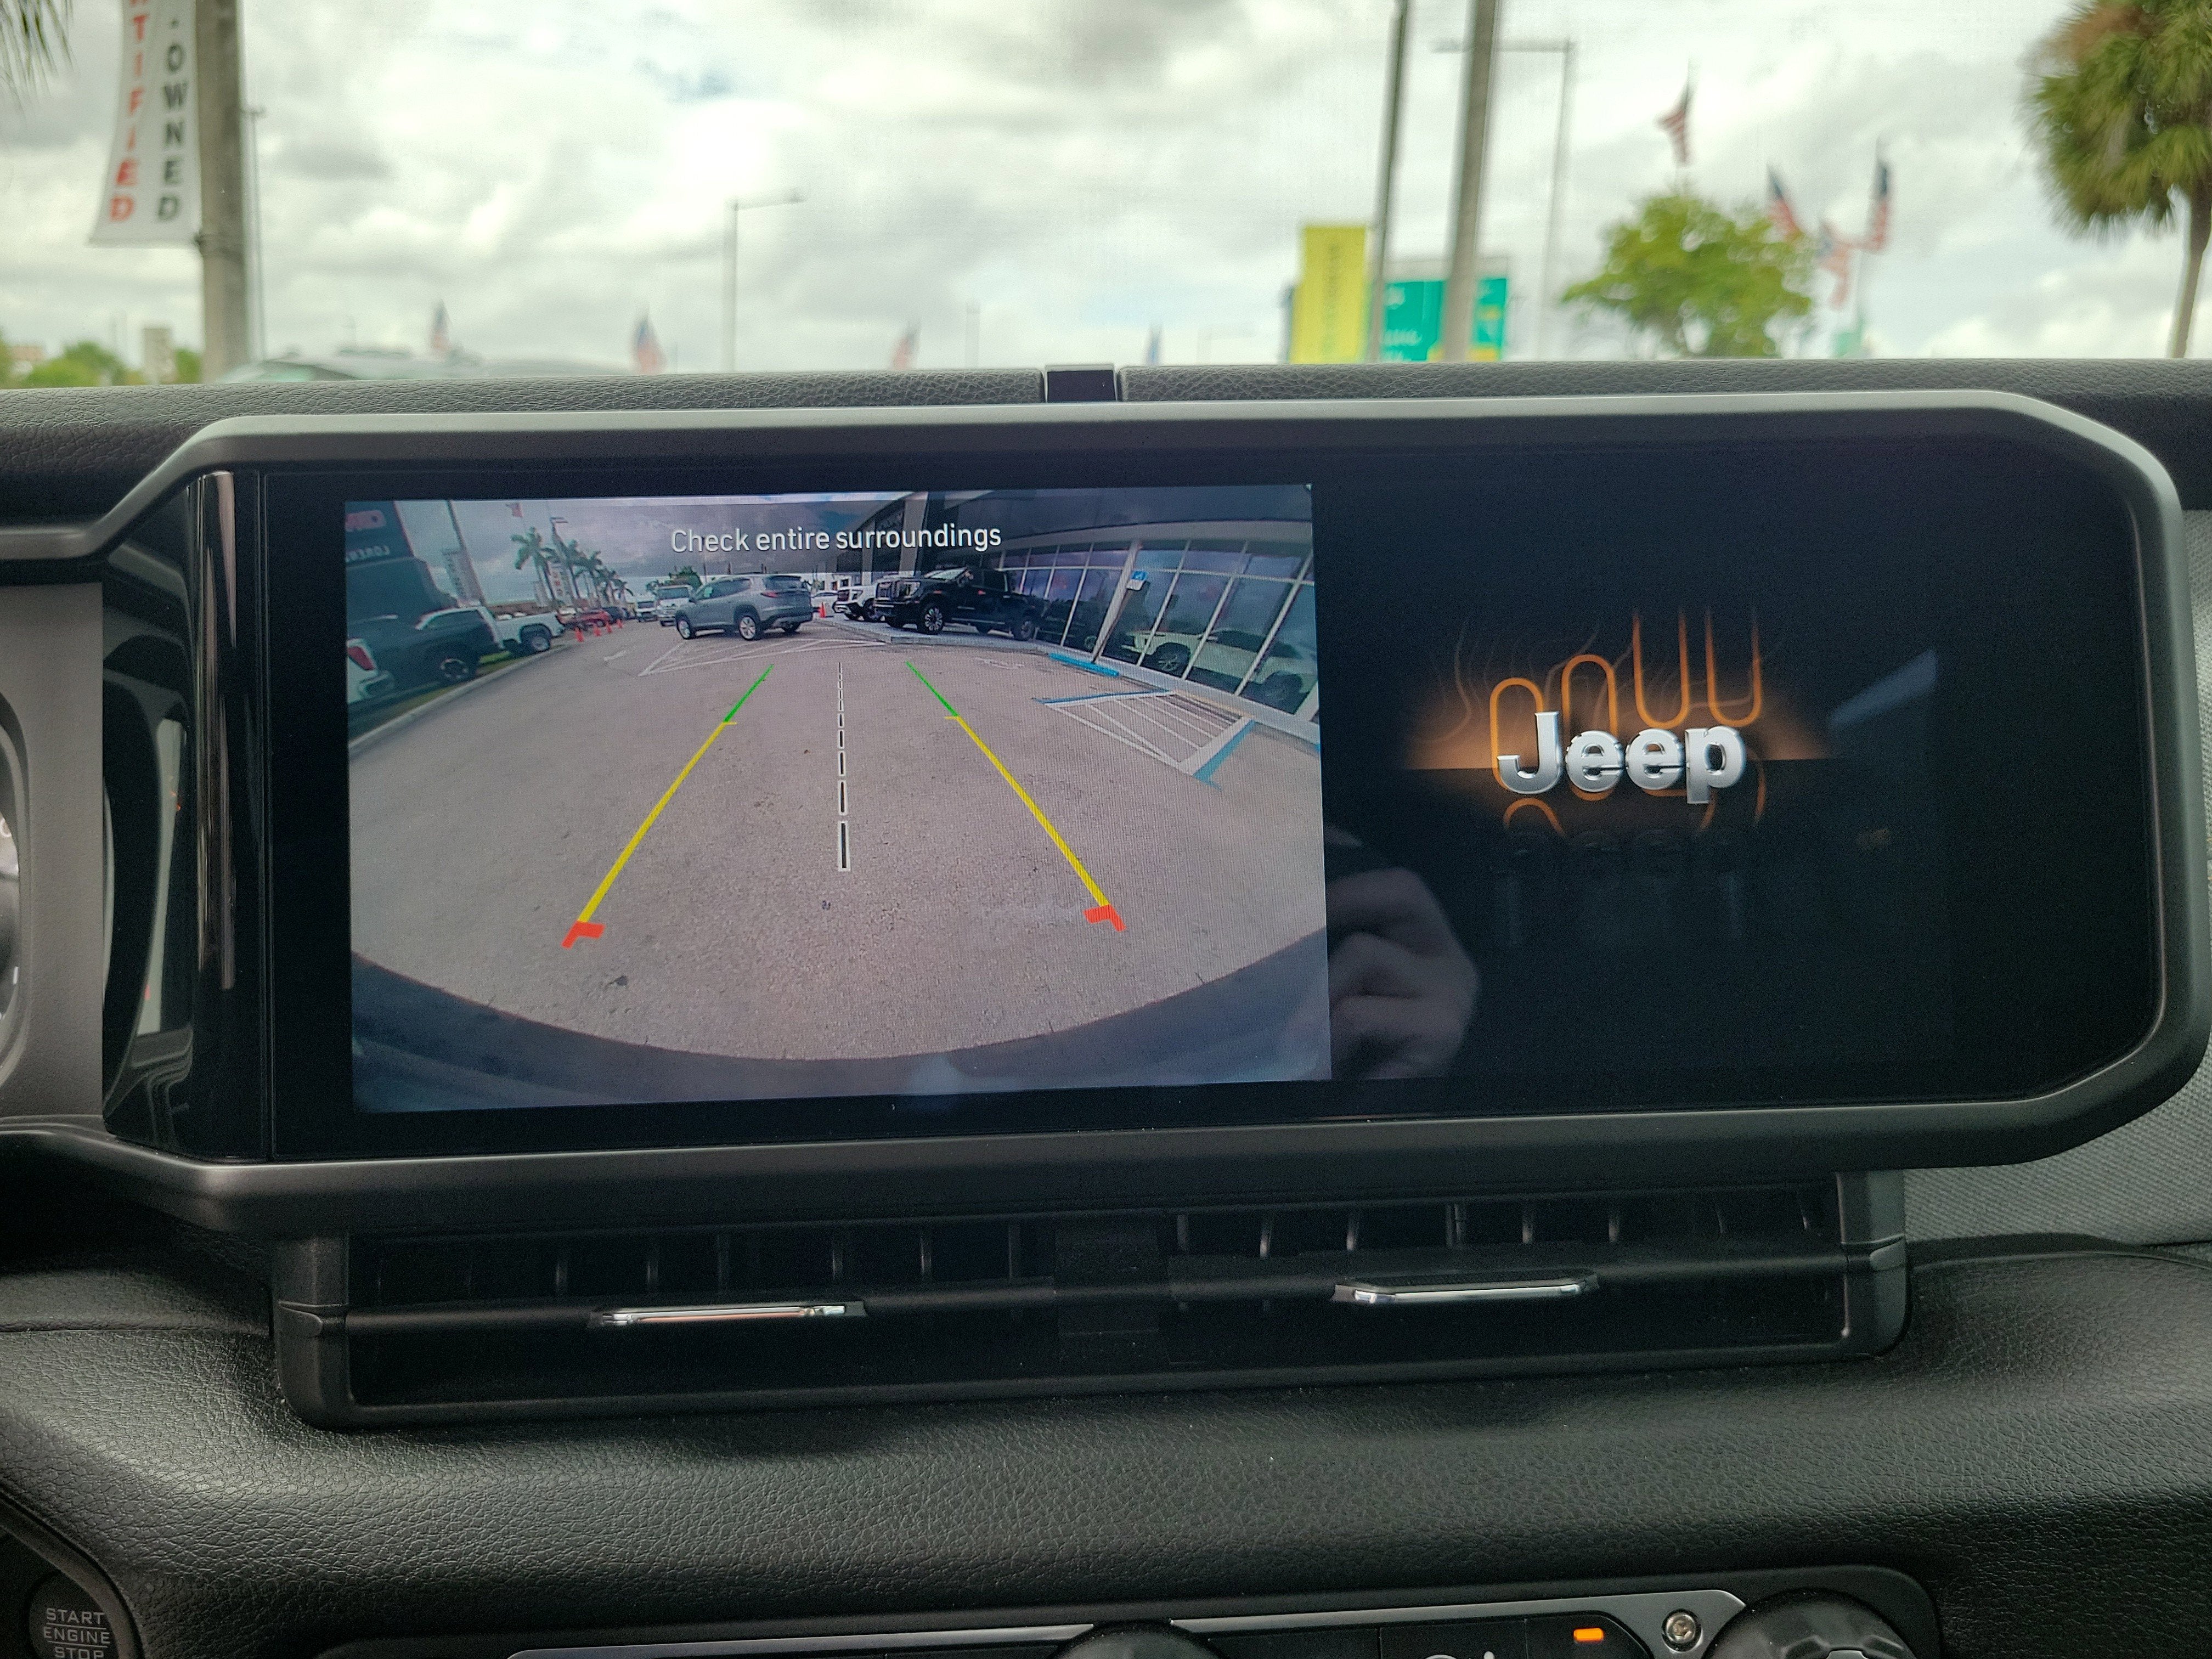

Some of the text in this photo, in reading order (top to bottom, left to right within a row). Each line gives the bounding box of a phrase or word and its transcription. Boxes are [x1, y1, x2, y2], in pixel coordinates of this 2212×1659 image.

[109, 0, 150, 222] TIFIED
[672, 523, 1001, 552] Check entire surroundings
[1497, 711, 1746, 804] Jeep
[46, 1607, 105, 1624] START
[43, 1626, 110, 1645] ENGINE
[55, 1646, 104, 1659] STOP
